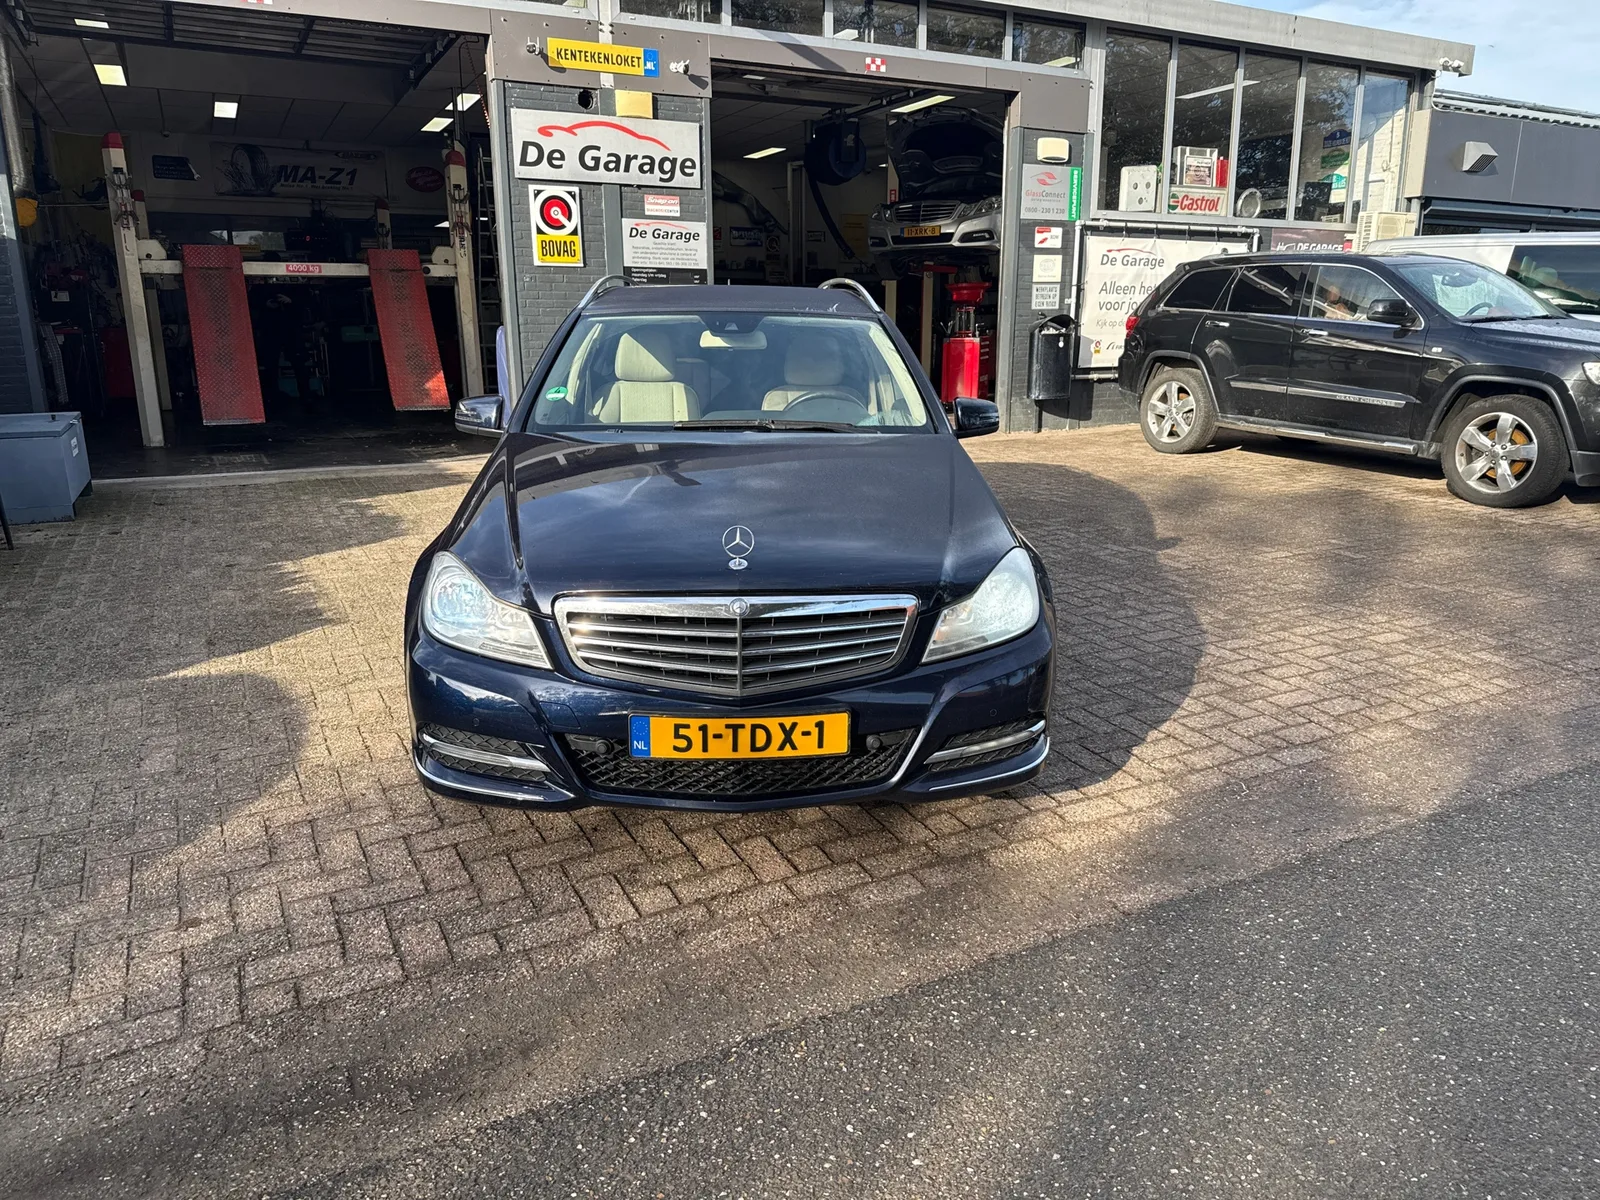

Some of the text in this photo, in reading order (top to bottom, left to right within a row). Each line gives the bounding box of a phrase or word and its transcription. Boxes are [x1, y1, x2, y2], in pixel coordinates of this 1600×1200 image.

[556, 47, 641, 69] KENTEKENLOKET
[519, 140, 697, 183] De Garage
[278, 164, 358, 186] MA-Z1
[646, 196, 679, 205] Snap-on
[1025, 189, 1066, 199] GlassConnect
[1071, 169, 1079, 219] SERVICEPUNT
[1180, 194, 1221, 212] Castrol
[629, 227, 648, 239] De
[652, 228, 700, 243] Garage
[907, 227, 936, 236] 11-XRK-8
[541, 239, 577, 258] BOVAG
[1309, 243, 1344, 251] GARAGE
[288, 264, 320, 273] 4000 kg
[1100, 254, 1165, 270] De Garage
[1098, 281, 1137, 295] Alleen
[1098, 301, 1125, 311] voor
[1096, 319, 1108, 329] Kijk
[1108, 321, 1117, 329] op
[633, 720, 825, 753] NL 51-TDX-1
